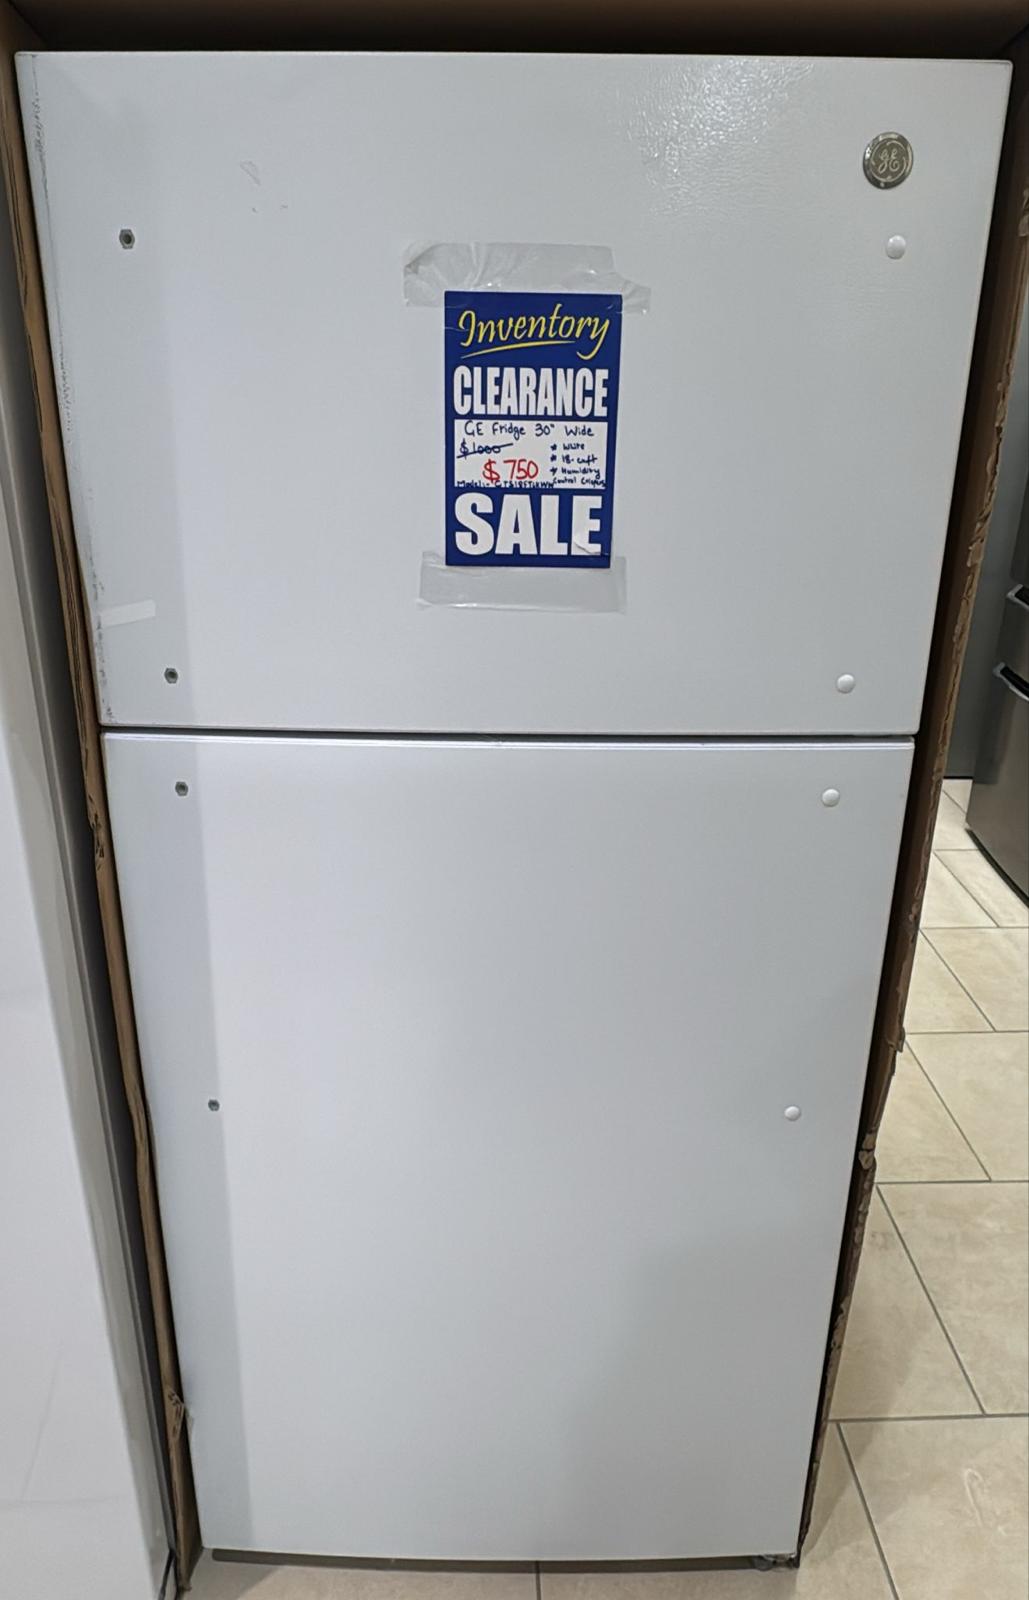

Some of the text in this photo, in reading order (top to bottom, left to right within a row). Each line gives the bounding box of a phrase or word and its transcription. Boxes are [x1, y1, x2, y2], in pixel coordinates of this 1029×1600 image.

[458, 303, 610, 360] Inventory
[453, 365, 609, 417] CLEARANCE
[464, 420, 484, 437] GE
[492, 421, 526, 441] Fridge
[564, 424, 595, 437] Wide
[454, 492, 603, 556] SALE
